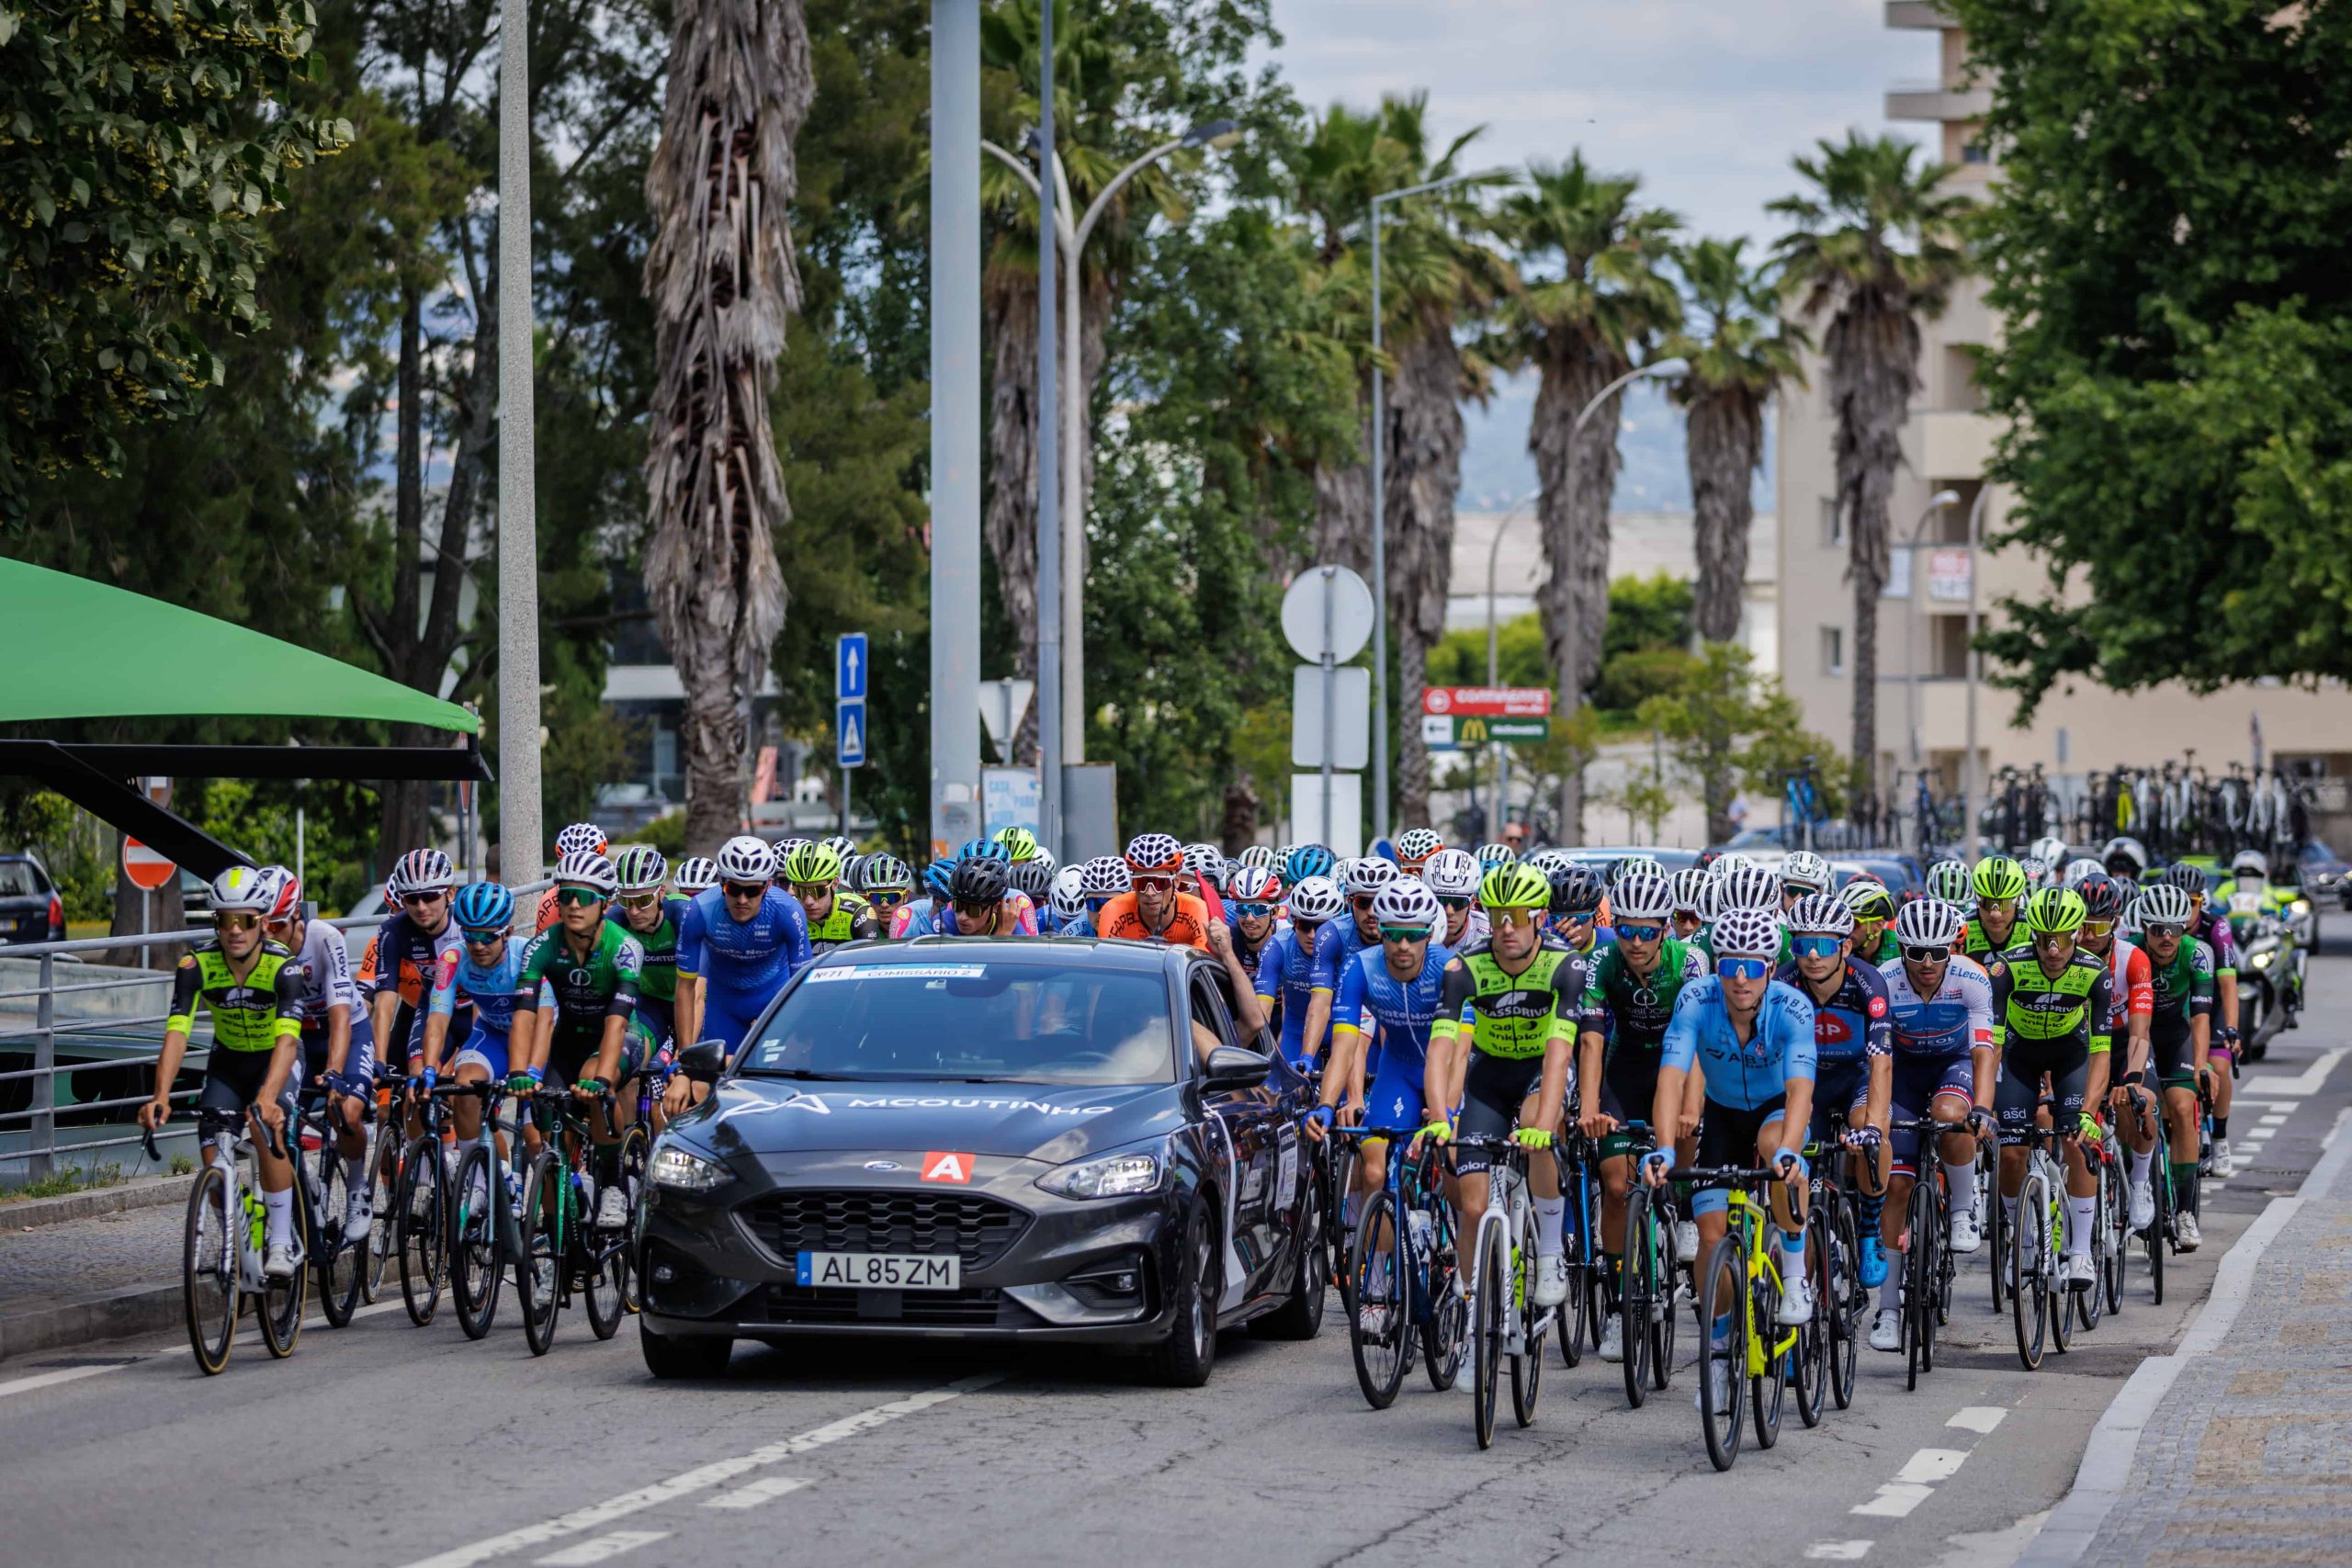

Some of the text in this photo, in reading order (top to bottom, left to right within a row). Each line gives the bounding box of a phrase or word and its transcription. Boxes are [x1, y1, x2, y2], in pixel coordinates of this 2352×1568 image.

[1314, 931, 1331, 970] BOLFLEX
[1586, 946, 1609, 989] RENFLOW
[1336, 958, 1355, 1004] BOLFLEX
[1853, 970, 1873, 997] Pelcorte
[1782, 996, 1814, 1021] ABTF
[1871, 1002, 1884, 1012] RP
[848, 1098, 1114, 1116] MCOUTINHO
[2003, 1108, 2027, 1120] asd
[926, 1155, 964, 1180] A
